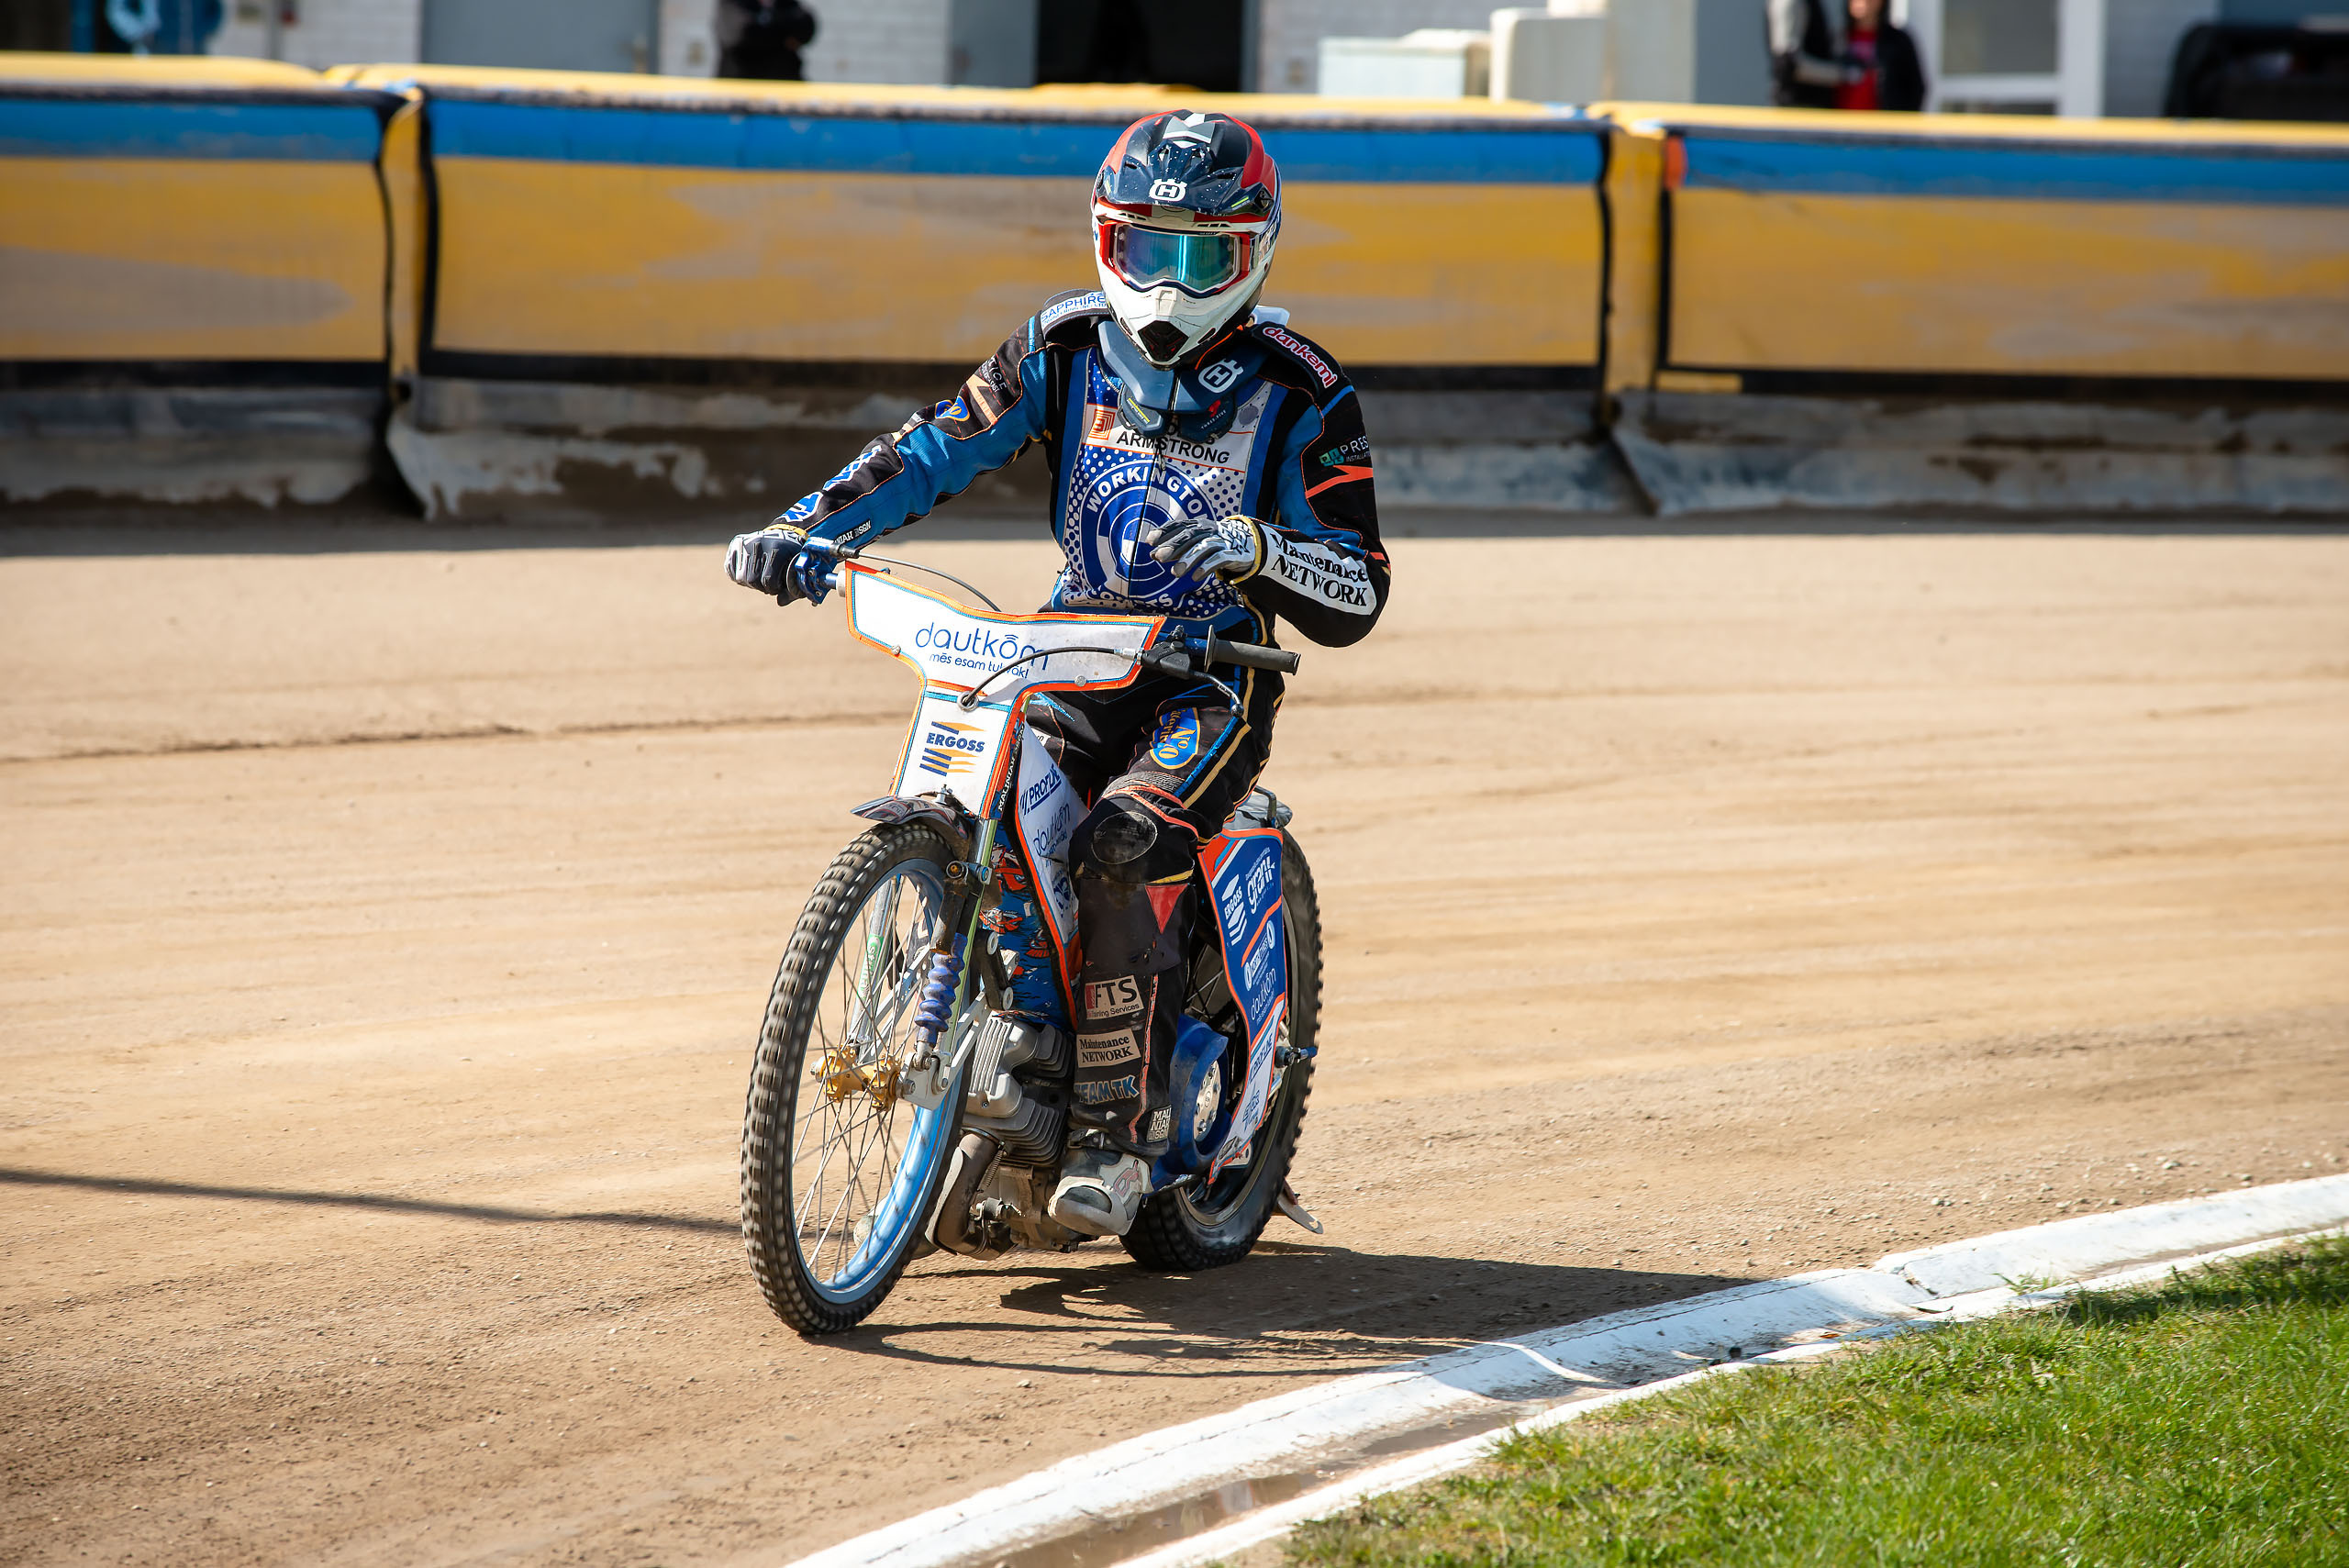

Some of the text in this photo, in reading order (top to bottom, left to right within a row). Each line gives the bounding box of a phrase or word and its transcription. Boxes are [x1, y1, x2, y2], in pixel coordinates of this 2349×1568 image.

[1263, 327, 1338, 389] dankemi
[1116, 430, 1230, 464] ARMSTRONG
[1270, 553, 1367, 606] NETWORK
[954, 656, 985, 671] esam
[926, 732, 985, 753] ERGOSS
[1224, 885, 1243, 920] ERGOSS
[1095, 978, 1138, 1009] FTS
[1109, 1003, 1140, 1016] Services
[1079, 1035, 1130, 1050] Maintenance
[1082, 1046, 1134, 1063] NETWORK
